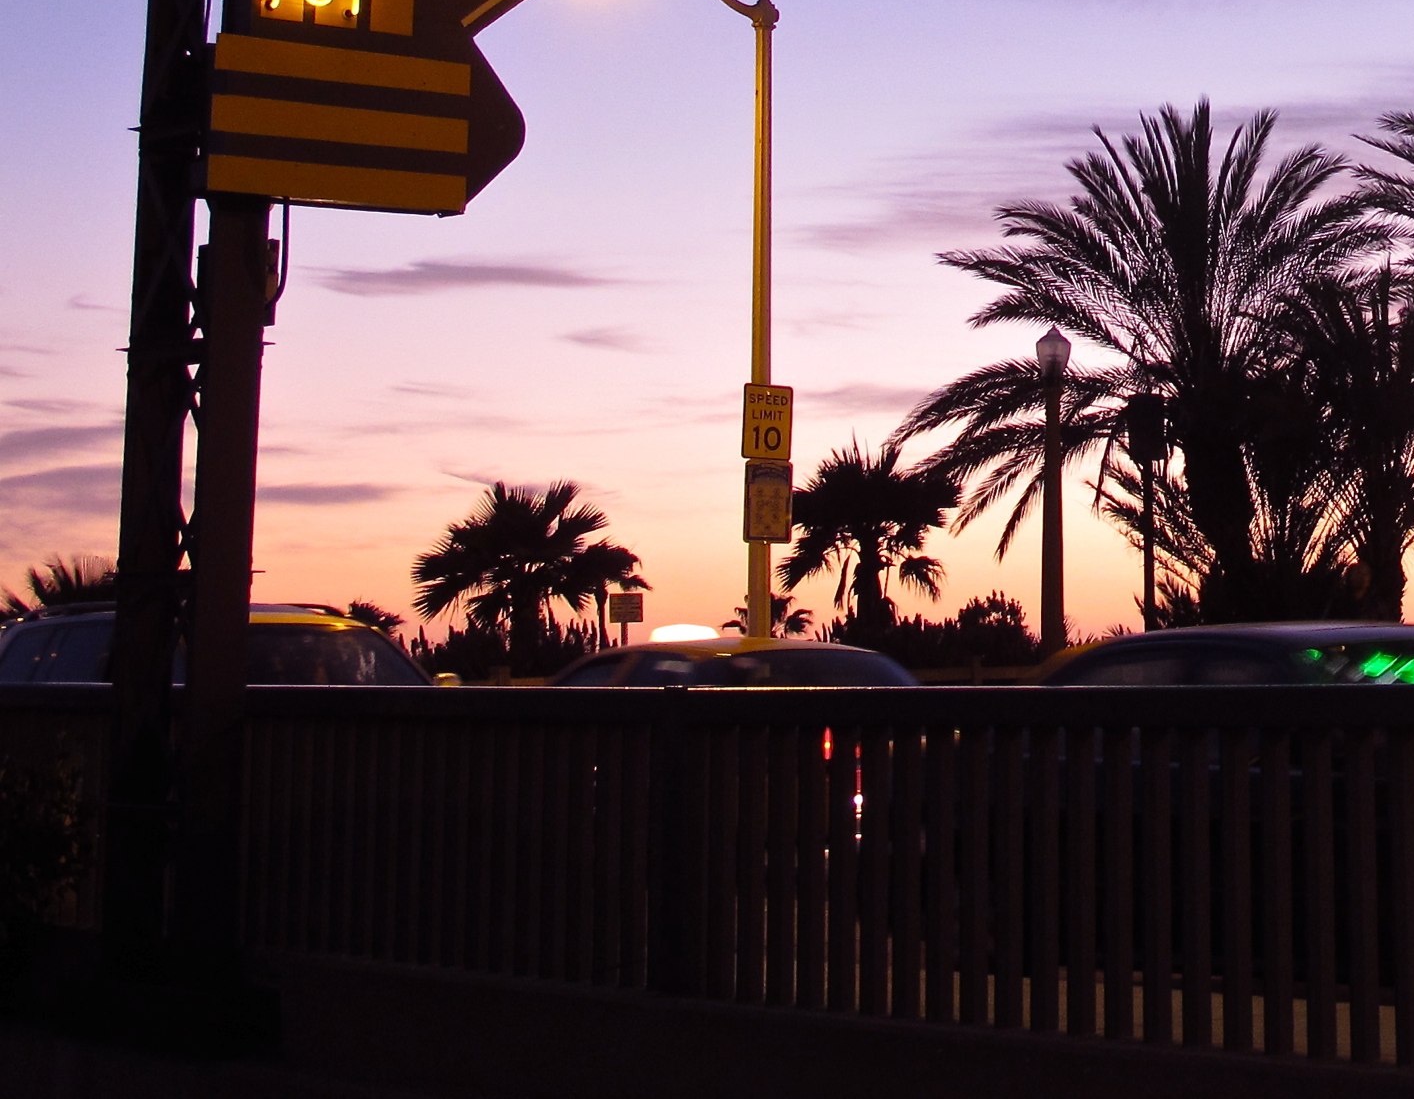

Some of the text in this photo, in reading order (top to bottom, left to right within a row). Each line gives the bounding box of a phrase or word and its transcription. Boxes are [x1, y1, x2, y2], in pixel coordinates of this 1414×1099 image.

[750, 394, 787, 405] SPEED
[753, 411, 784, 420] LIMIT
[754, 427, 781, 450] 10
